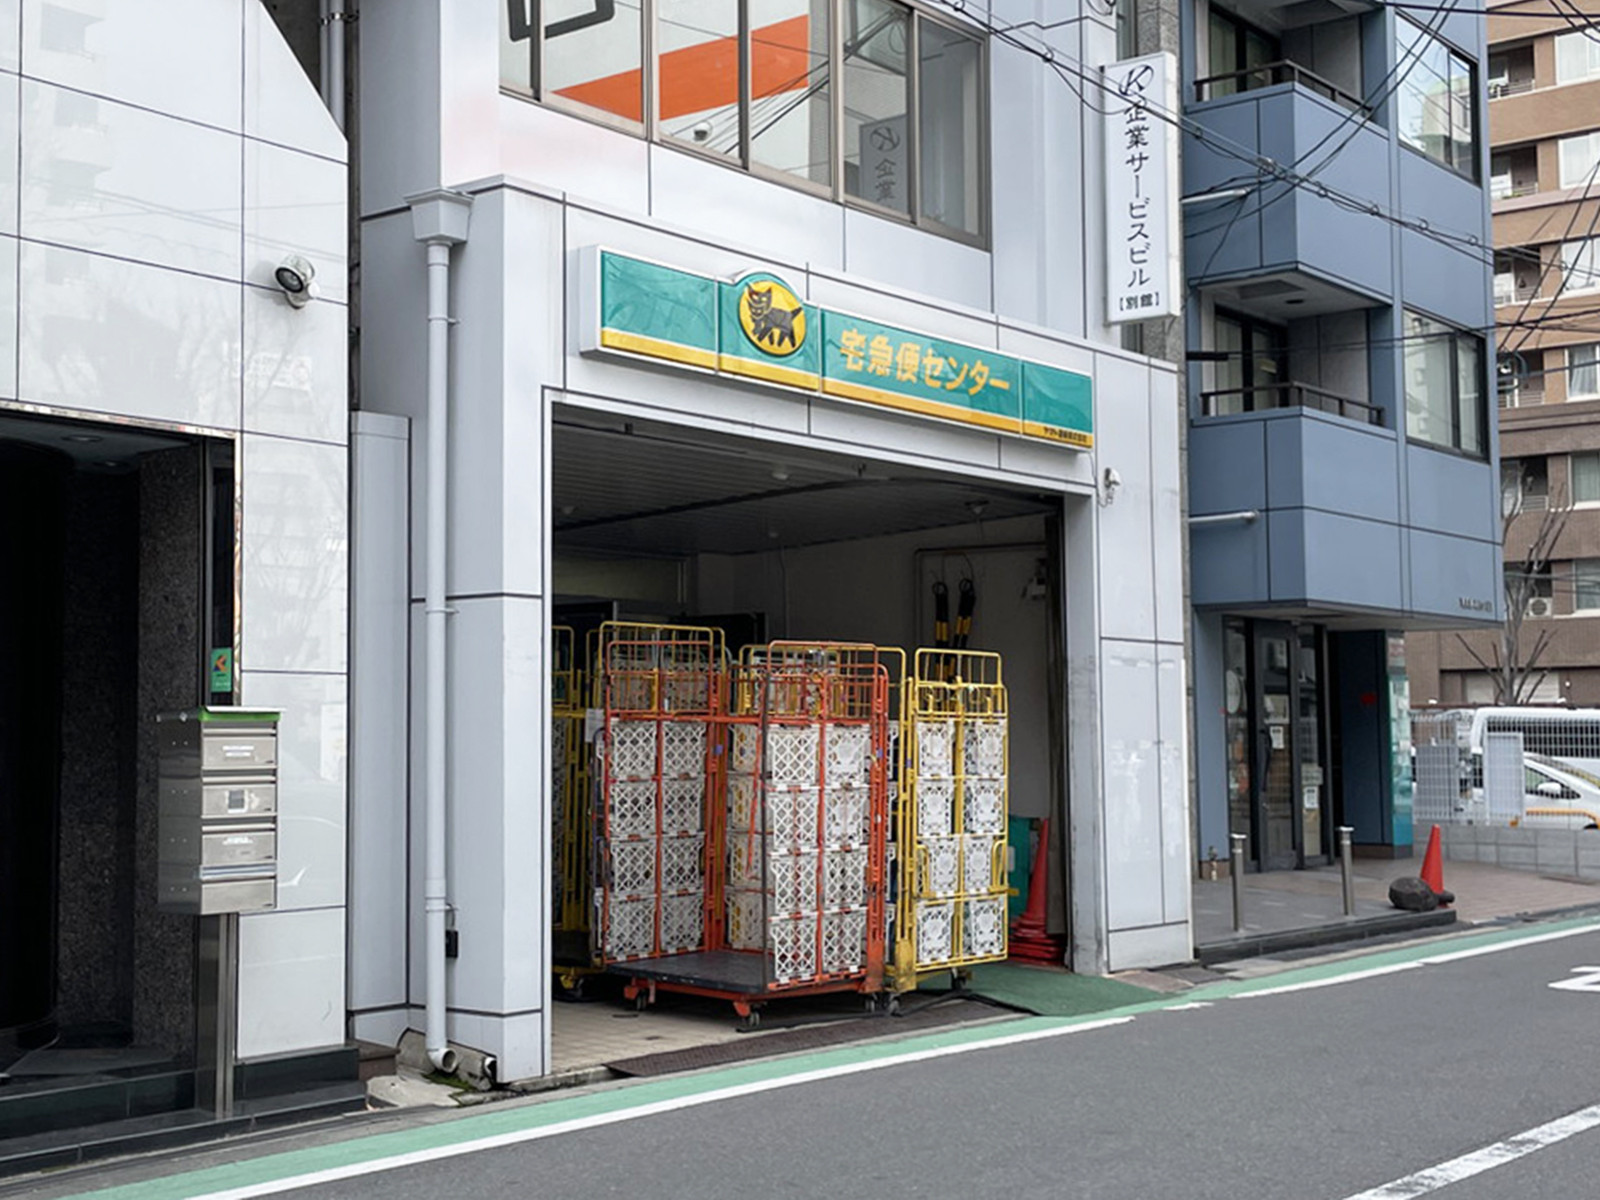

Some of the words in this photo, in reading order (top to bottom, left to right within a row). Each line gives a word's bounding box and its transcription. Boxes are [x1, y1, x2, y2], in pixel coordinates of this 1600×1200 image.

[1124, 100, 1151, 288] 企業サービスビル
[839, 328, 1010, 396] 宅急便センター
